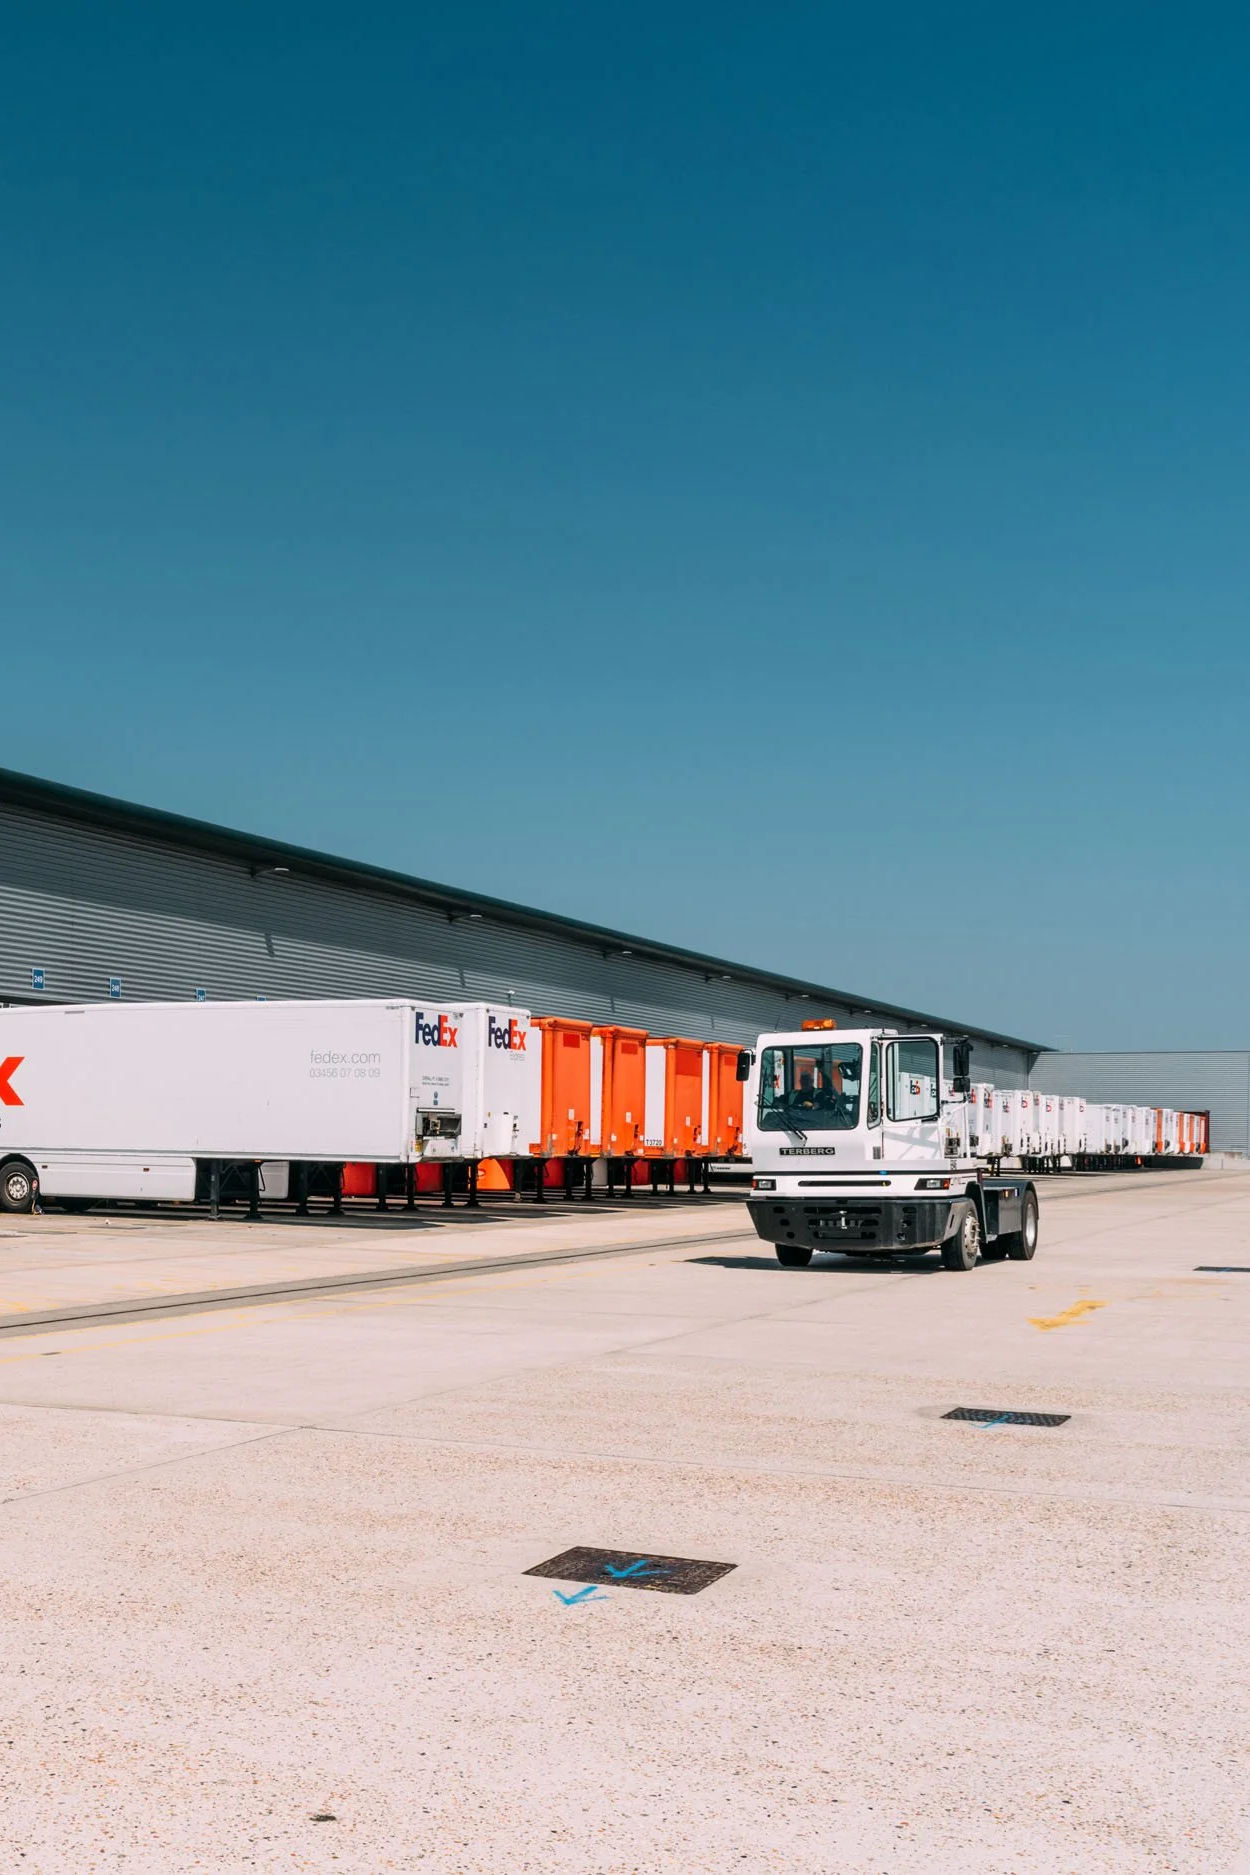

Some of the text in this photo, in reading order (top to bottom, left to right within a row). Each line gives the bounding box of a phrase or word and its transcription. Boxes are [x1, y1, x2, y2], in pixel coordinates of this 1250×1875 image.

[415, 1011, 458, 1049] FedEx
[488, 1015, 527, 1052] FedEx
[310, 1049, 381, 1065] fedex.com
[340, 1067, 352, 1079] 07
[781, 1147, 835, 1156] TERBERG
